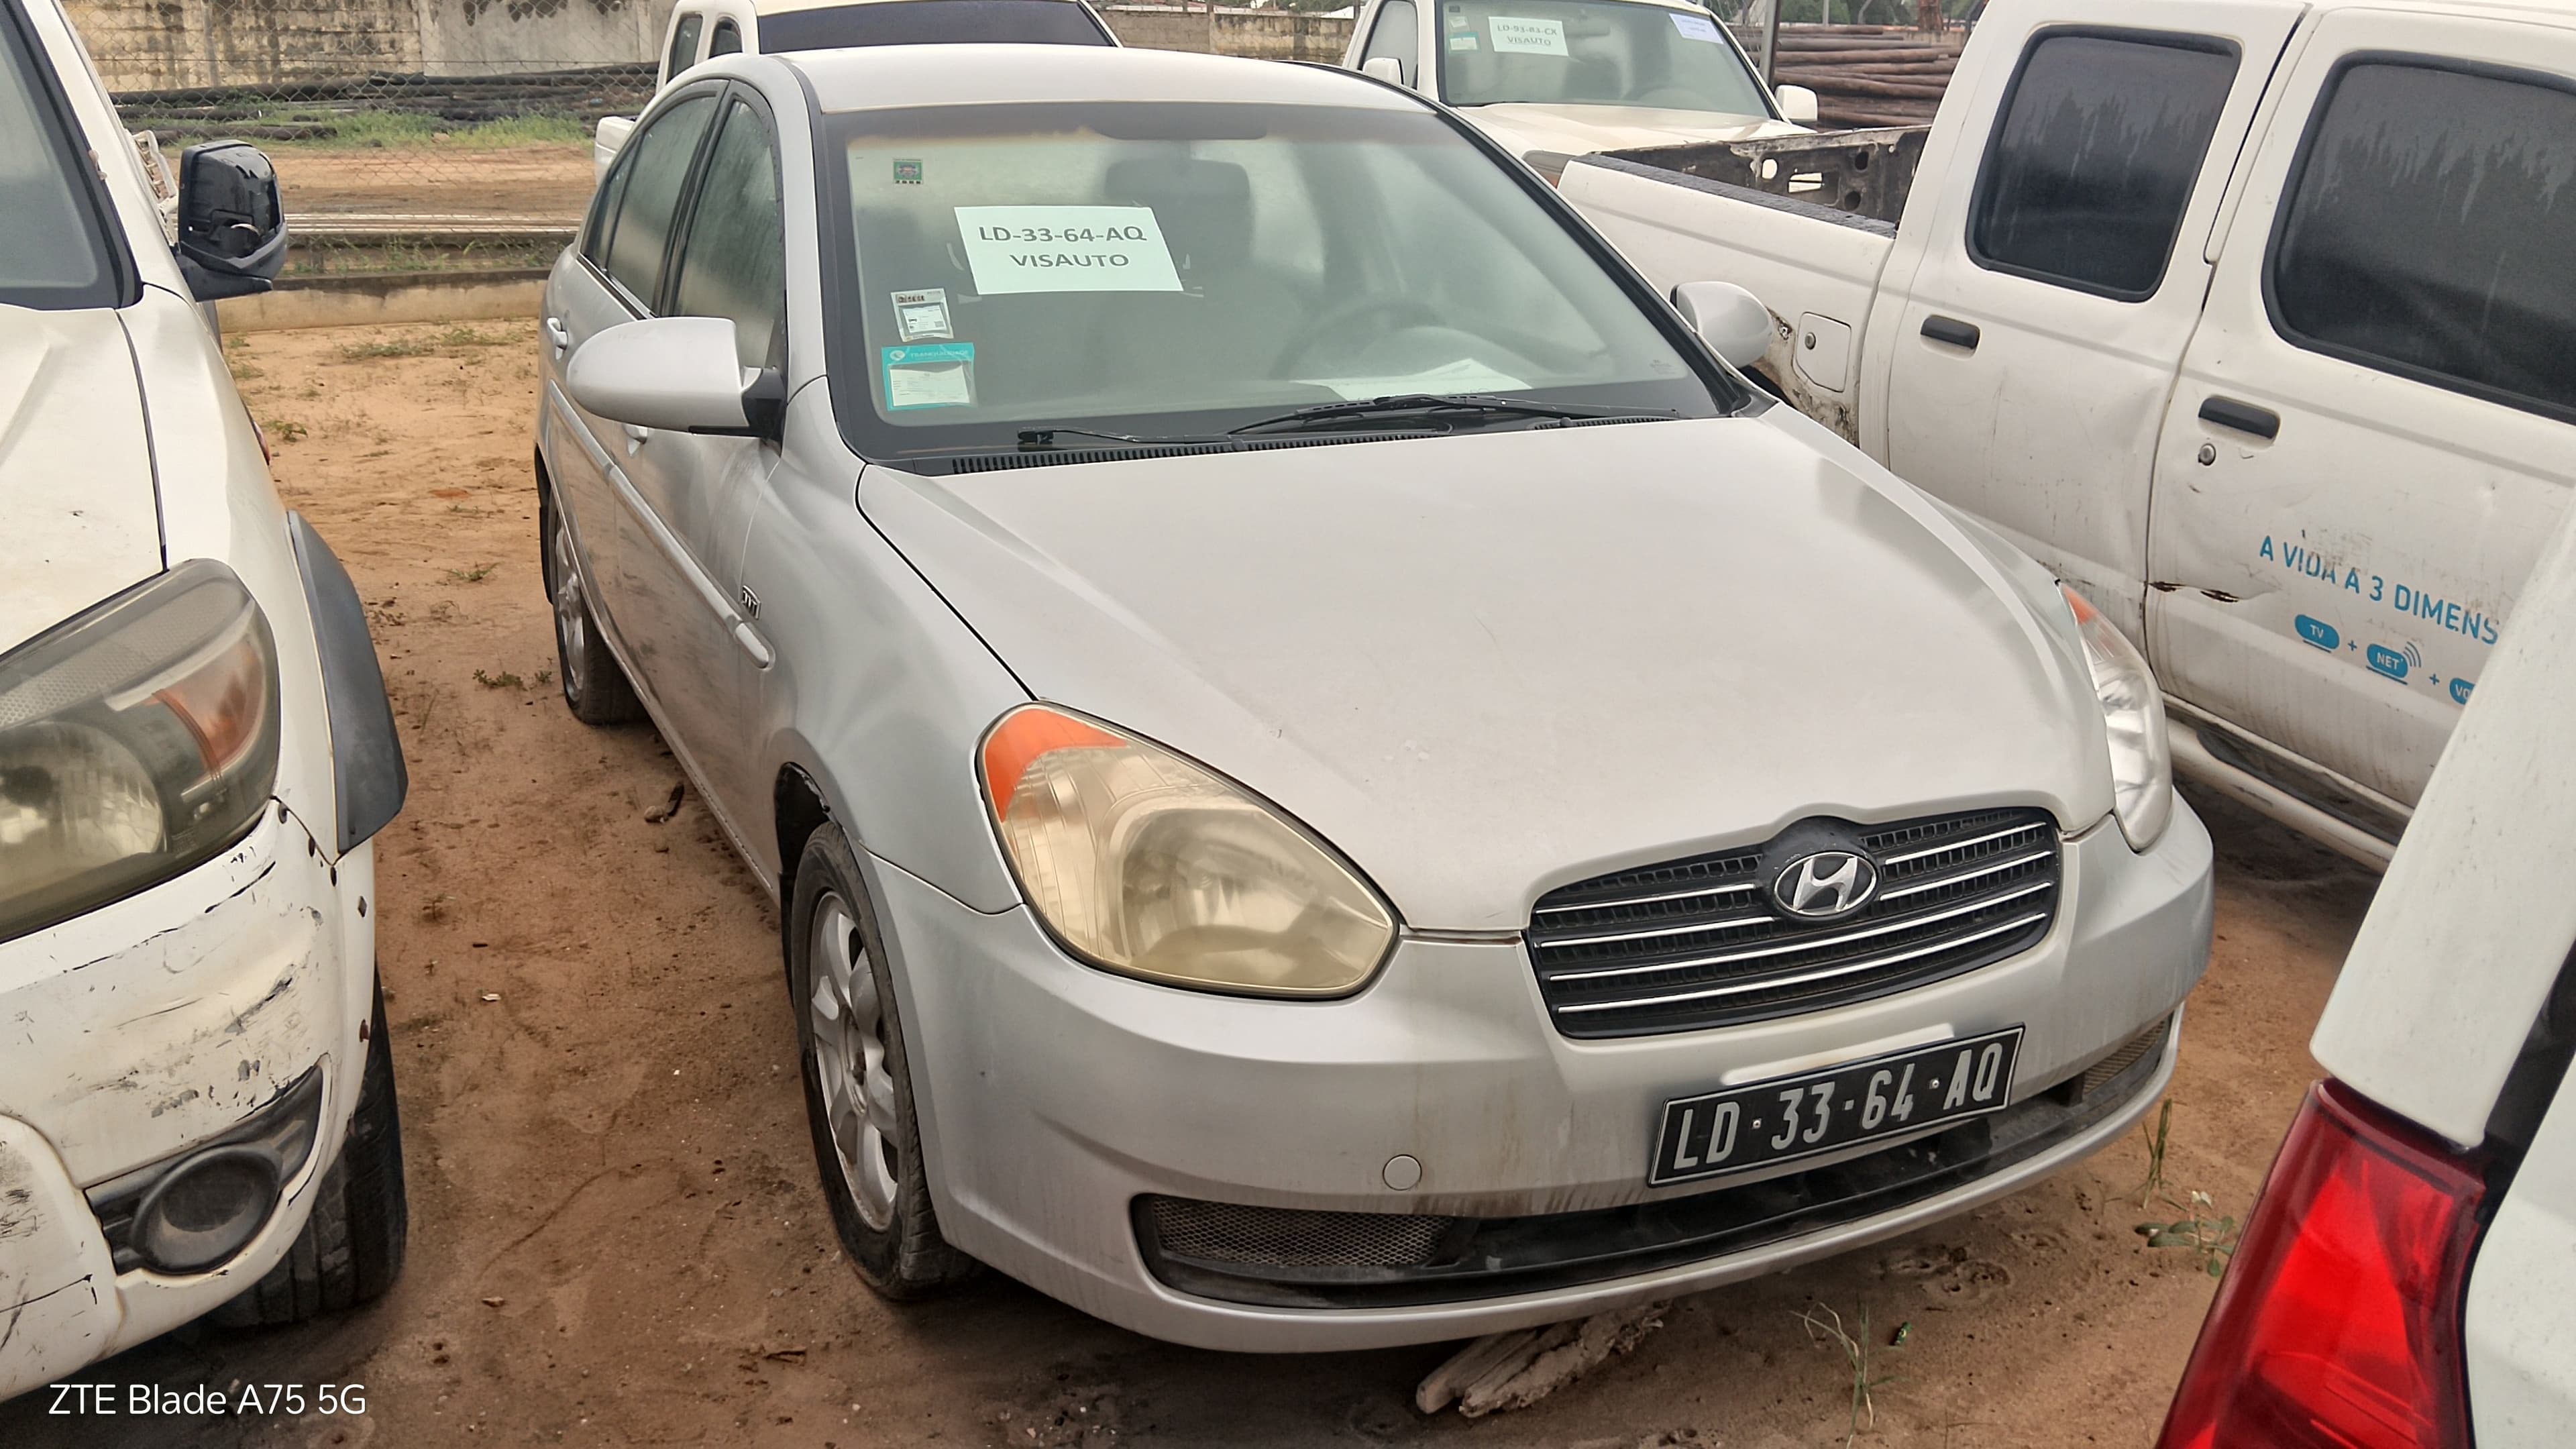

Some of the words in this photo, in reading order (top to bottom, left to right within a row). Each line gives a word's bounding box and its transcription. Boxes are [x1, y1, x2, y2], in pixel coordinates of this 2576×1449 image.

[1507, 36, 1552, 46] VISAUTO
[979, 226, 1147, 242] LD-33-64-AQ
[1010, 254, 1129, 267] VISAUTO
[2259, 535, 2273, 561] A
[2283, 542, 2336, 584] VIDA
[2345, 567, 2360, 594] A
[2369, 576, 2383, 601] 3
[2394, 584, 2499, 645] DIMENS
[2309, 624, 2324, 639] TV
